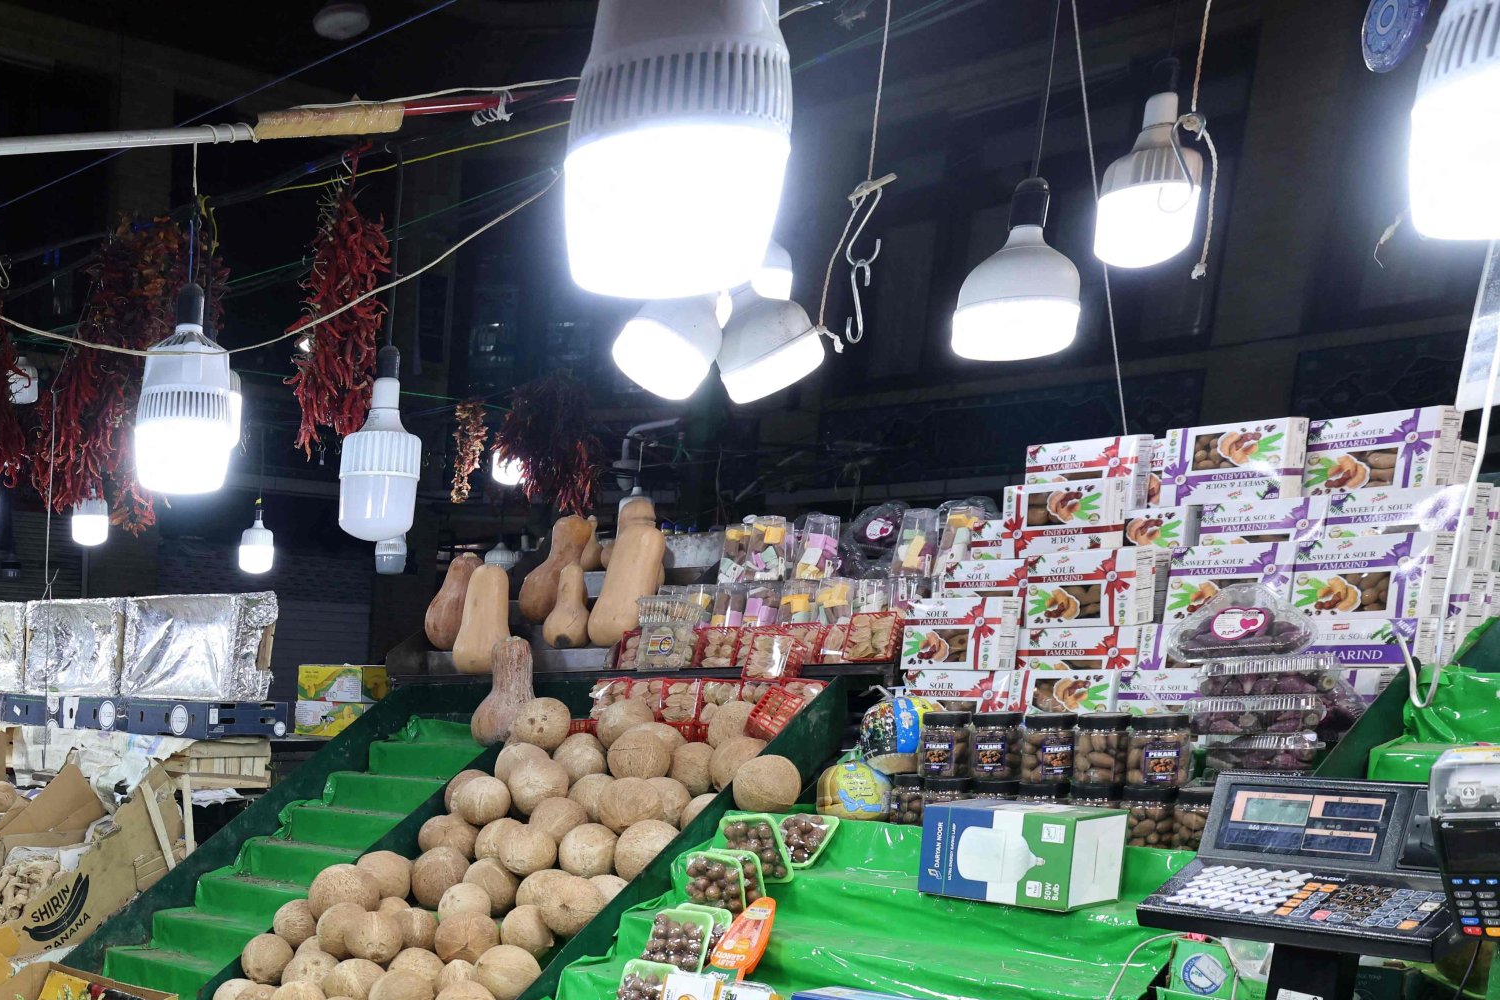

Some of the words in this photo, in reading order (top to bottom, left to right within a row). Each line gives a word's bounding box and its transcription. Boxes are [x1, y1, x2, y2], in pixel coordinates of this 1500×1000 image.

[1322, 432, 1351, 440] SWEET
[1360, 428, 1385, 436] SOUR
[1327, 438, 1378, 449] TAMARIND
[1051, 454, 1076, 463] SOUR
[1042, 462, 1085, 472] TAMARIND
[1344, 505, 1375, 514] SWEET
[1387, 503, 1413, 511] SOUR
[1215, 515, 1244, 524] SWEET
[1253, 514, 1276, 522] SOUR
[1043, 527, 1085, 536] TAMARIND
[1220, 523, 1269, 533] TAMARIND
[1051, 536, 1075, 545] SOUR
[1311, 552, 1341, 561] SWEET
[1351, 551, 1376, 559] SOUR
[1184, 559, 1212, 568] SWEET
[1222, 558, 1244, 566] SOUR
[1316, 560, 1369, 570] TAMARIND
[1050, 566, 1075, 574] SOUR
[1188, 567, 1237, 576] TAMARIND
[966, 573, 990, 581] SOUR
[1041, 574, 1084, 583] TAMARIND
[926, 610, 949, 618] SOUR
[1052, 641, 1078, 649] SOUR
[929, 682, 954, 690] SOUR
[921, 690, 960, 698] TAMARIND
[934, 842, 942, 868] DARYAN
[1044, 882, 1052, 900] 50W
[31, 884, 70, 923] SHIRIN
